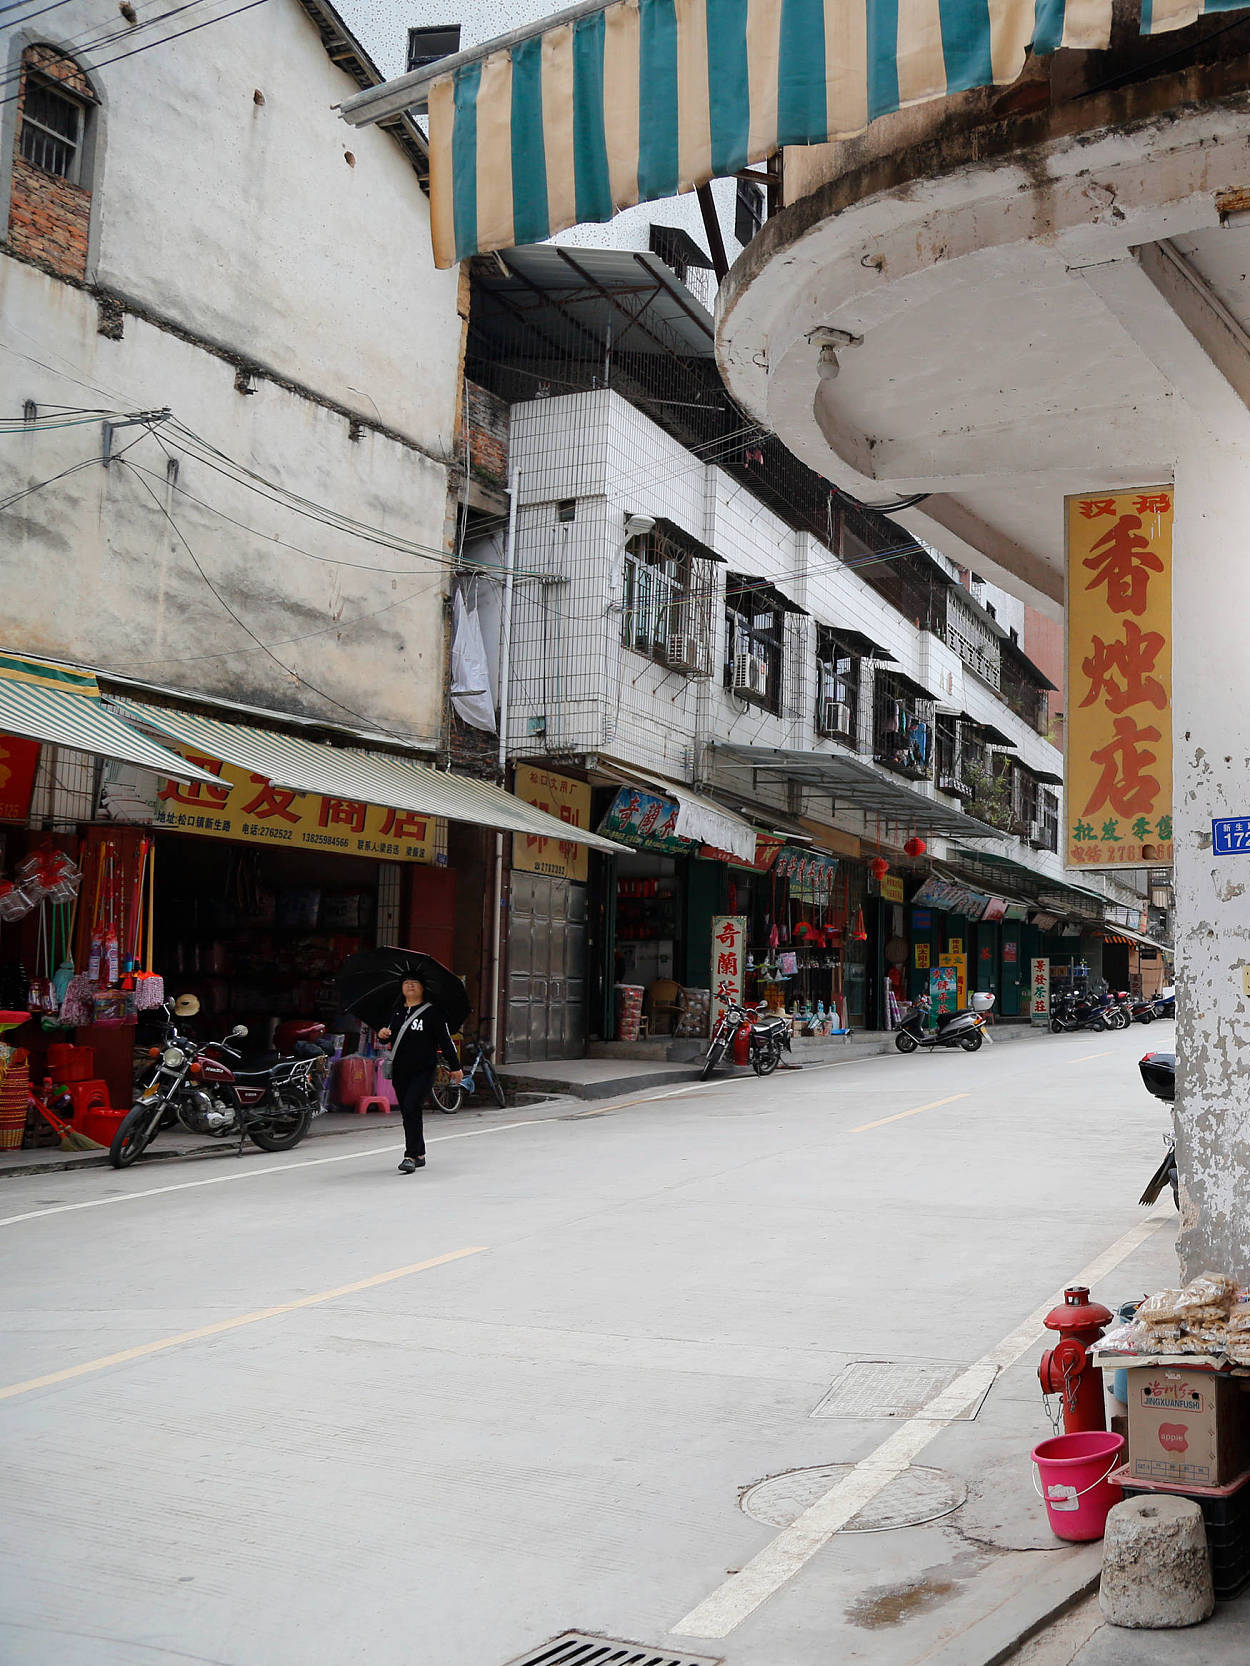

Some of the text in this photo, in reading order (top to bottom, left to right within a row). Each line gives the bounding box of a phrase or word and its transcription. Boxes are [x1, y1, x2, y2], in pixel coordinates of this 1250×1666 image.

[1080, 493, 1170, 519] 汉记
[1078, 514, 1168, 819] 香烛店
[1144, 1397, 1200, 1410] JINGXUANFUSHI
